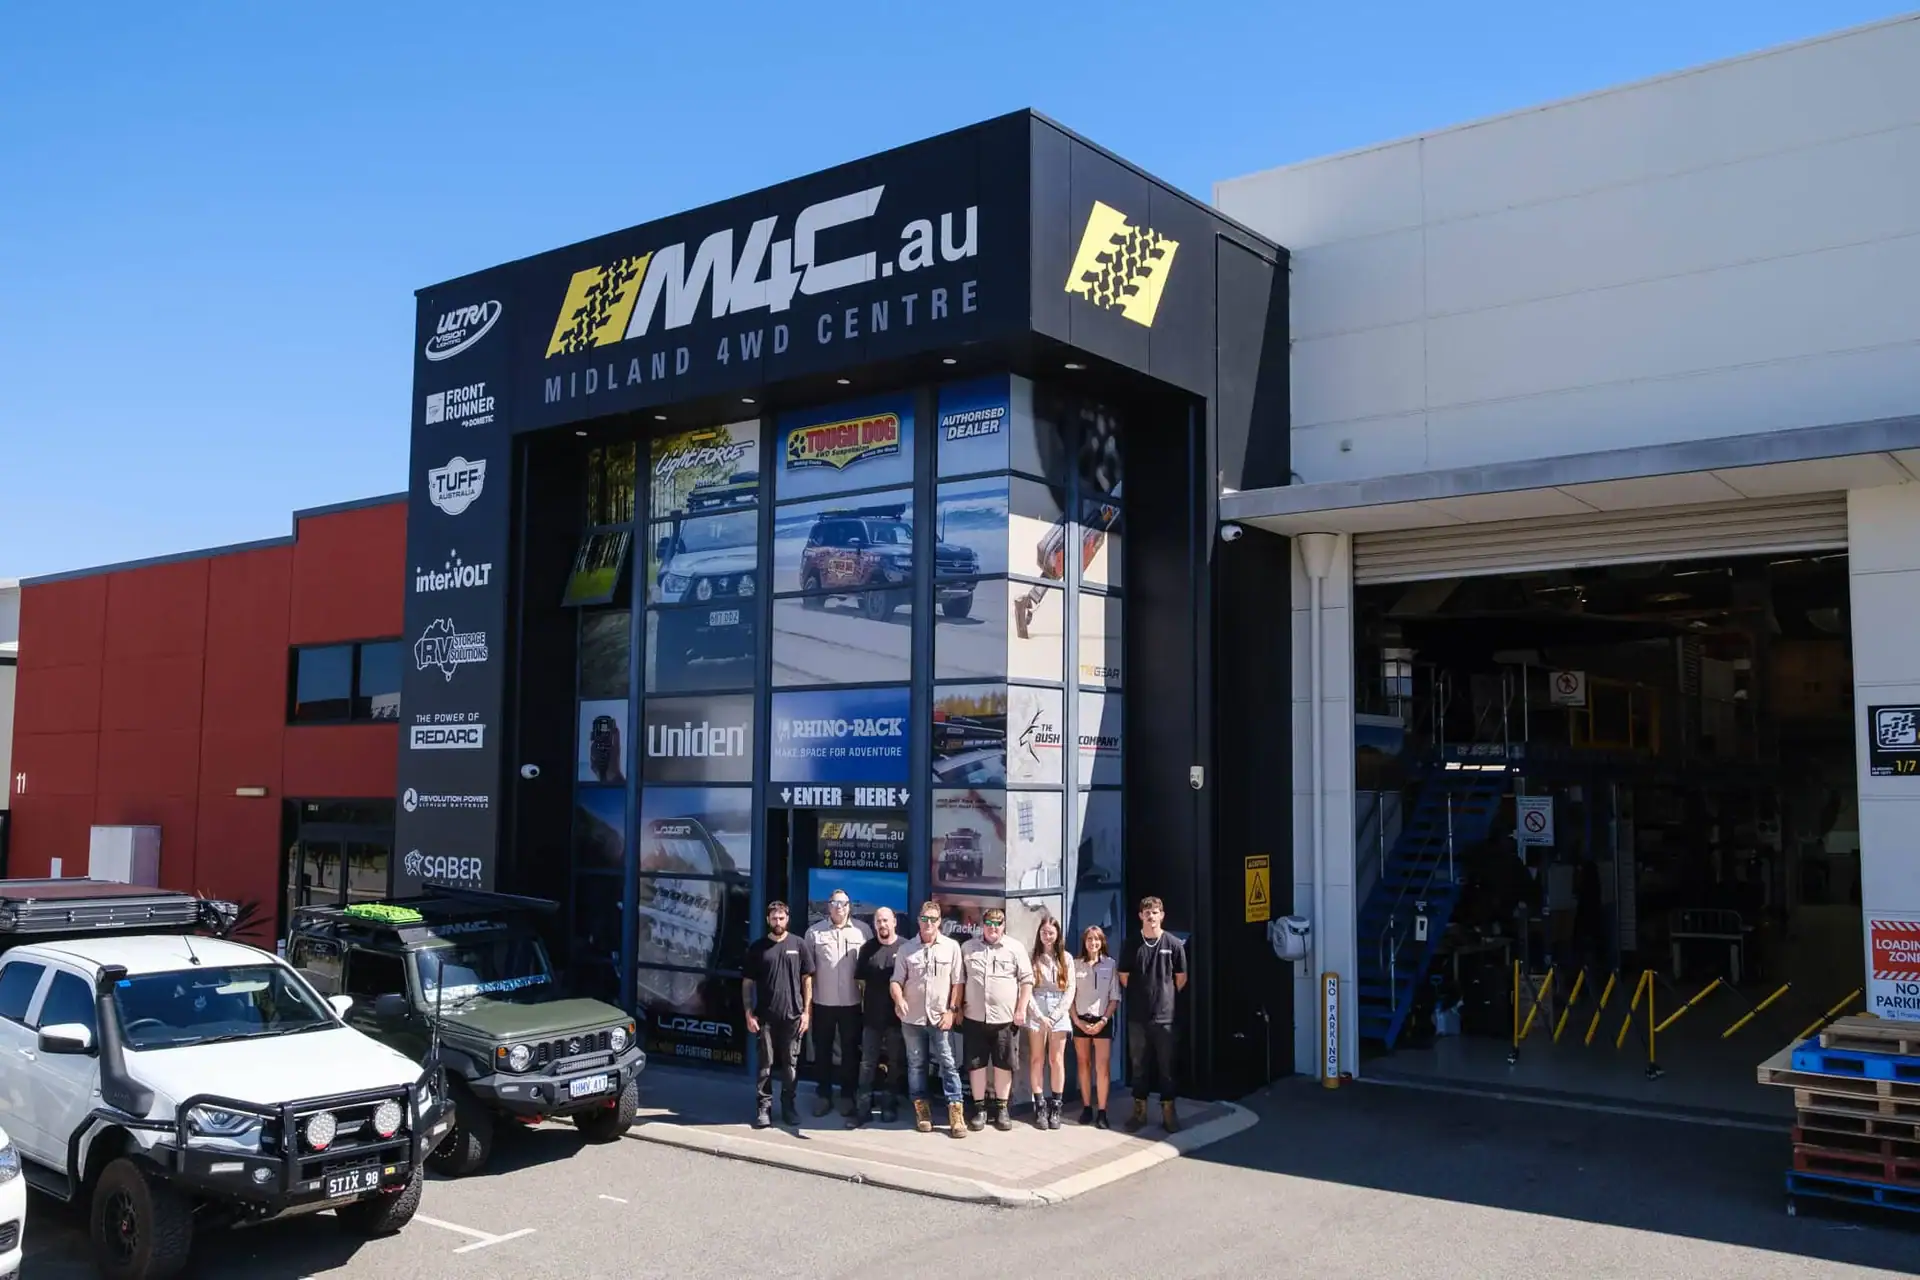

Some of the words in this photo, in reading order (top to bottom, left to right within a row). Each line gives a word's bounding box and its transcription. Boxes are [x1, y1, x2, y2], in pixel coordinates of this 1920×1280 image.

[436, 302, 487, 334] ULTRA
[545, 347, 690, 404] MIDLAND
[716, 325, 789, 365] 4WD
[817, 280, 978, 344] CENTRE
[446, 382, 486, 405] FRONT
[446, 396, 495, 420] RUNNER
[942, 407, 1005, 426] AUTHORISED
[806, 423, 859, 453] TOUGH
[862, 417, 896, 445] DOG
[947, 419, 999, 440] DEALER
[436, 468, 478, 493] TUFF
[453, 632, 486, 648] STORAGE
[449, 646, 489, 663] SOLUTIONS
[416, 714, 431, 723] THE
[434, 713, 465, 723] POWER
[467, 712, 480, 721] OF
[792, 717, 903, 738] RHINO-RACK
[1041, 723, 1053, 732] THE
[415, 728, 479, 745] REDARC
[648, 721, 744, 757] Uniden
[1035, 732, 1060, 744] BUSH
[1078, 735, 1119, 746] COMPANY
[775, 747, 797, 757] MAKE
[801, 747, 827, 757] SPACE
[829, 747, 846, 757] FOR
[848, 747, 902, 757] ADVENTURE
[16, 772, 26, 794] 11
[463, 795, 489, 803] POWER
[793, 786, 842, 806] ENTER
[854, 787, 897, 807] HERE
[833, 850, 857, 859] 1300
[423, 856, 482, 880] SABER
[1876, 939, 1920, 952] LOADIN
[1328, 979, 1336, 997] NO
[1895, 982, 1920, 996] NO
[1876, 995, 1920, 1010] PARKI
[1328, 1004, 1337, 1064] PARKING
[329, 1174, 360, 1194] STIX
[365, 1170, 379, 1186] 98
